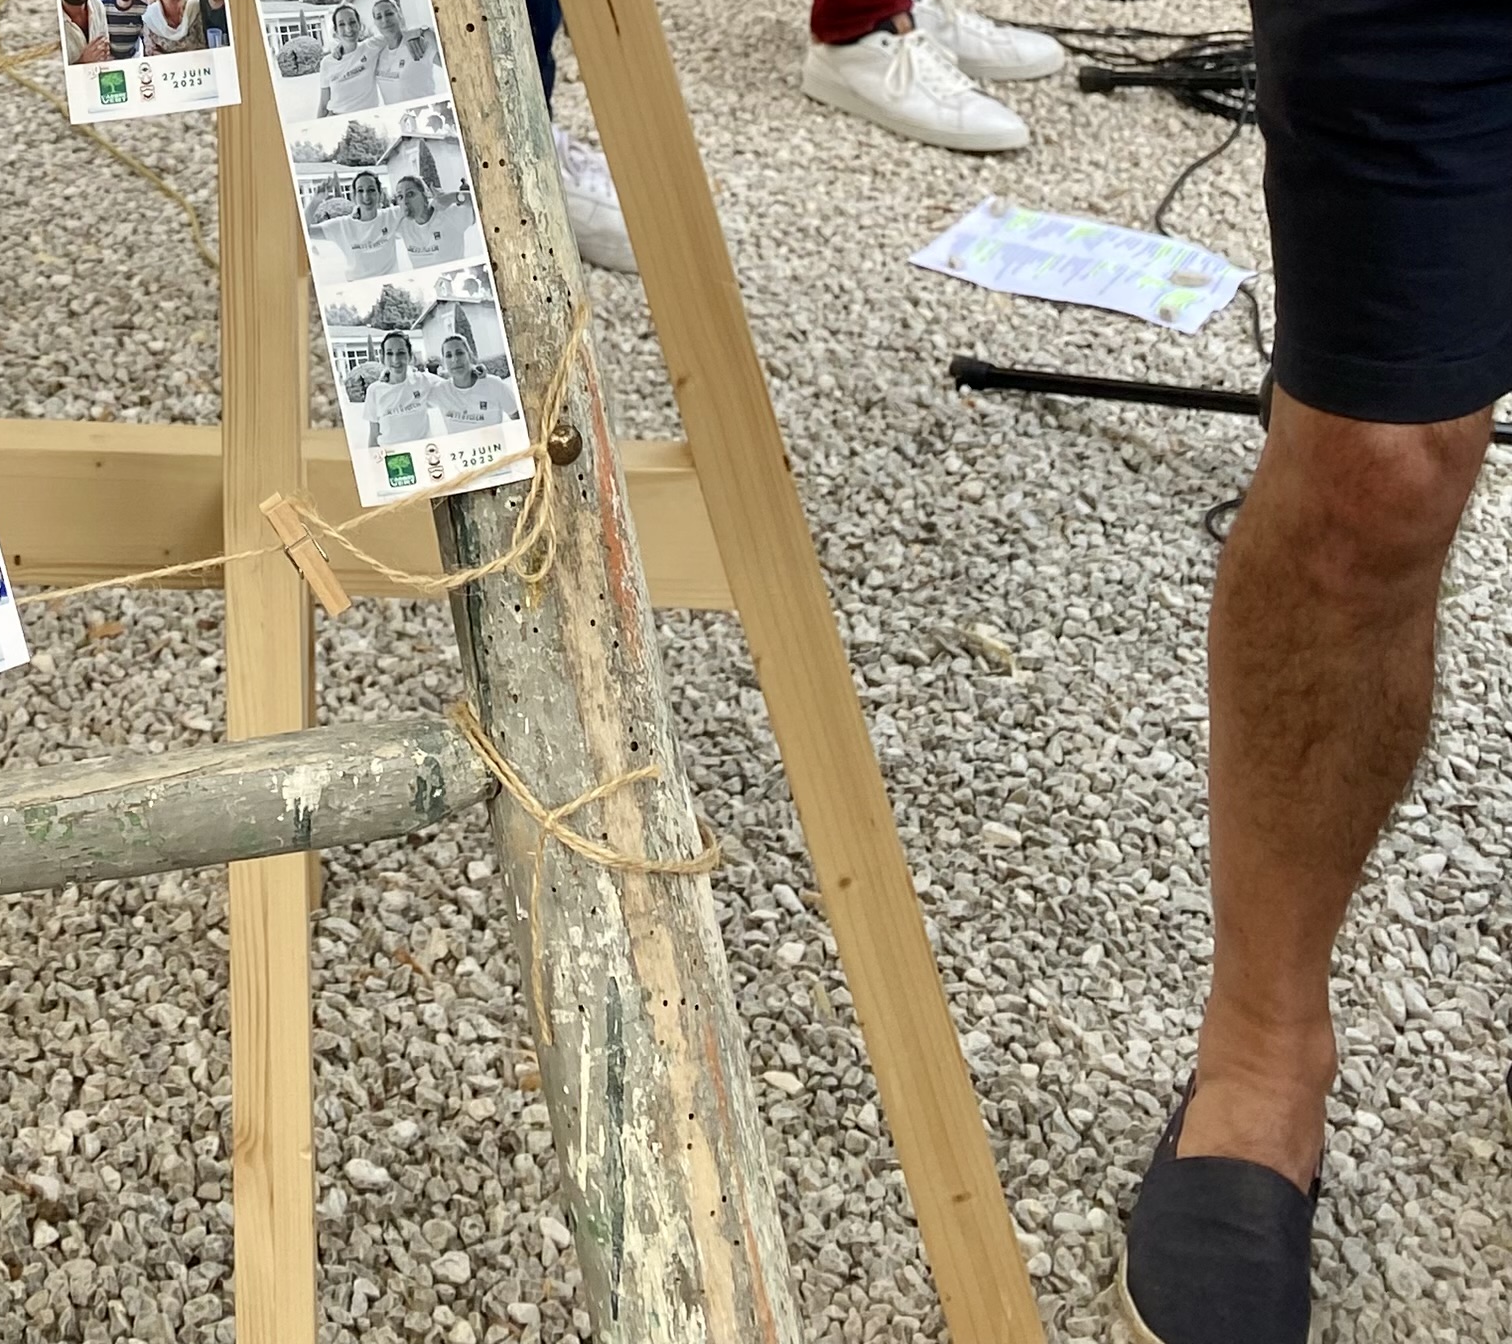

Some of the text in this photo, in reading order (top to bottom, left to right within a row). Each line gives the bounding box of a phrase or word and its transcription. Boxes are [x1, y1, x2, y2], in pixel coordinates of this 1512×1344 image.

[162, 68, 211, 81] 27 JUIN
[173, 78, 202, 88] 2023
[450, 443, 502, 461] 27 JUIN
[462, 455, 494, 467] 2023
